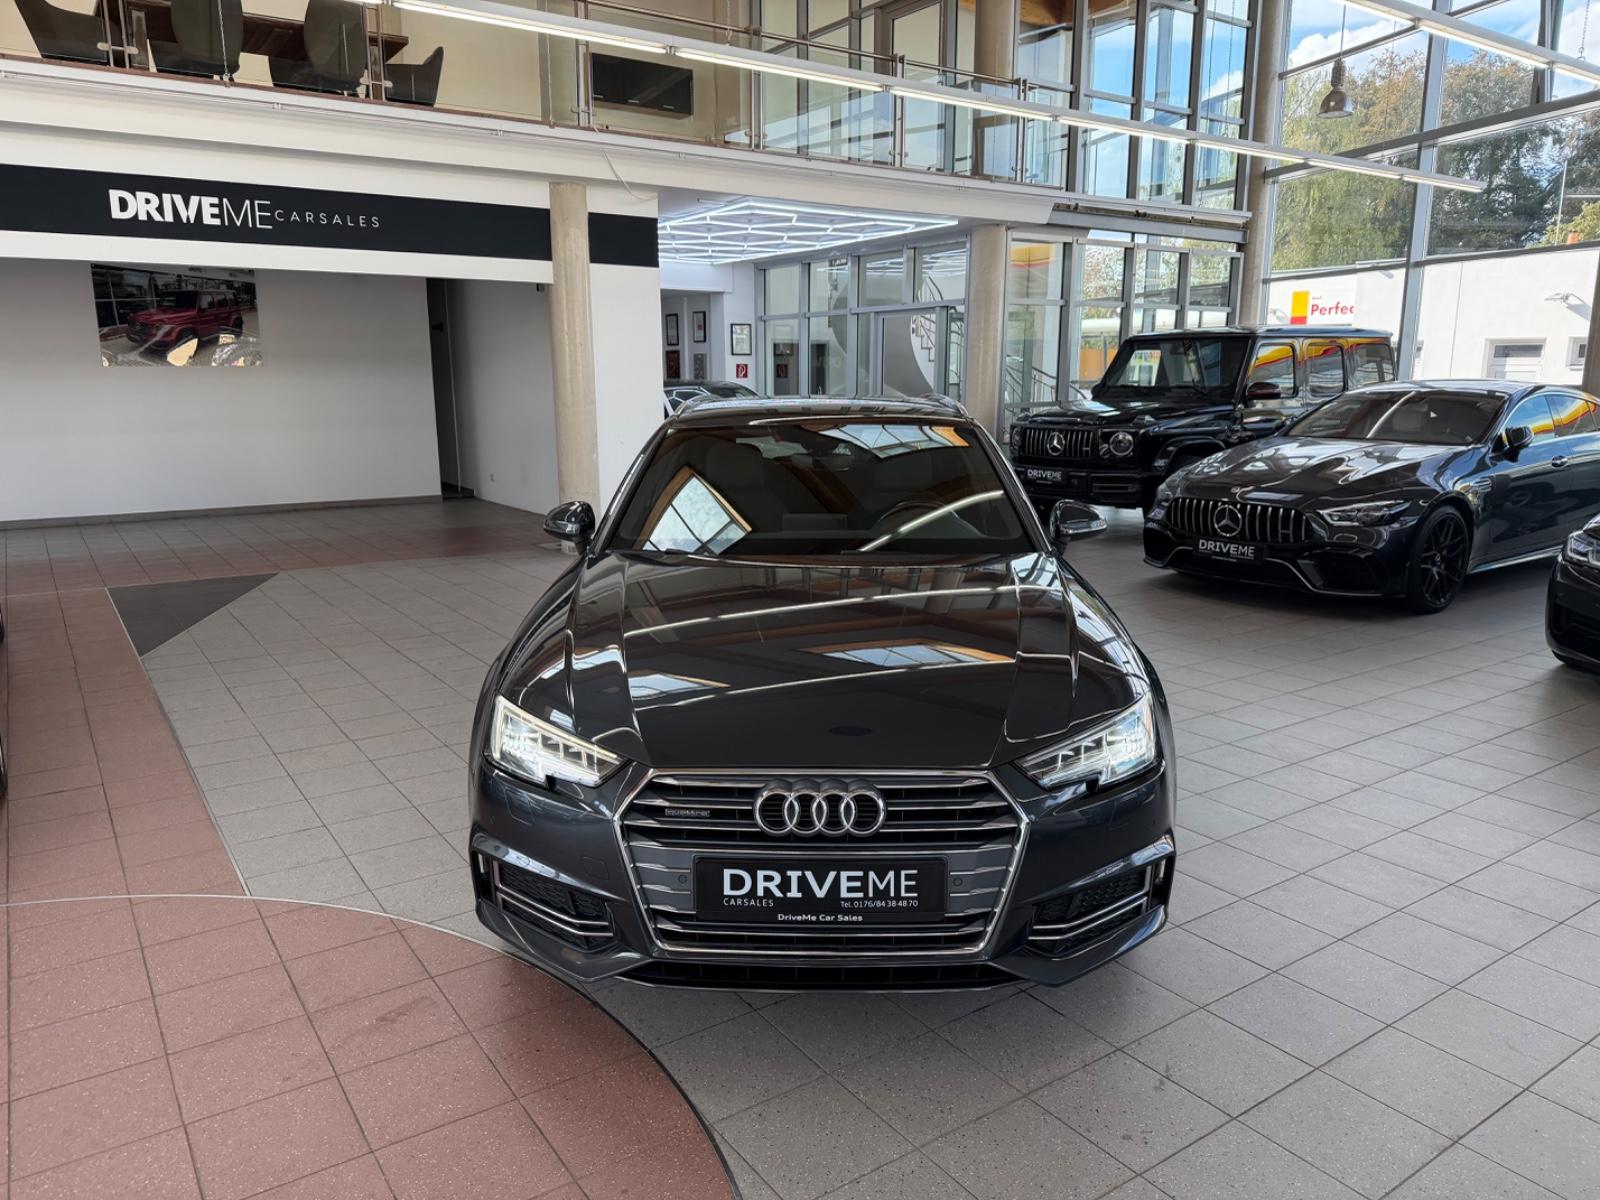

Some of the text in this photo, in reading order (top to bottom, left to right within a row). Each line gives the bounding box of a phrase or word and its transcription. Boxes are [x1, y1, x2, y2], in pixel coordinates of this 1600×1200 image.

[108, 189, 380, 229] DRIVEME CARSALES
[1199, 539, 1255, 557] DRIVEME
[723, 868, 918, 898] DRIVEME
[723, 897, 774, 907] CARSALES
[837, 914, 863, 922] Sales
